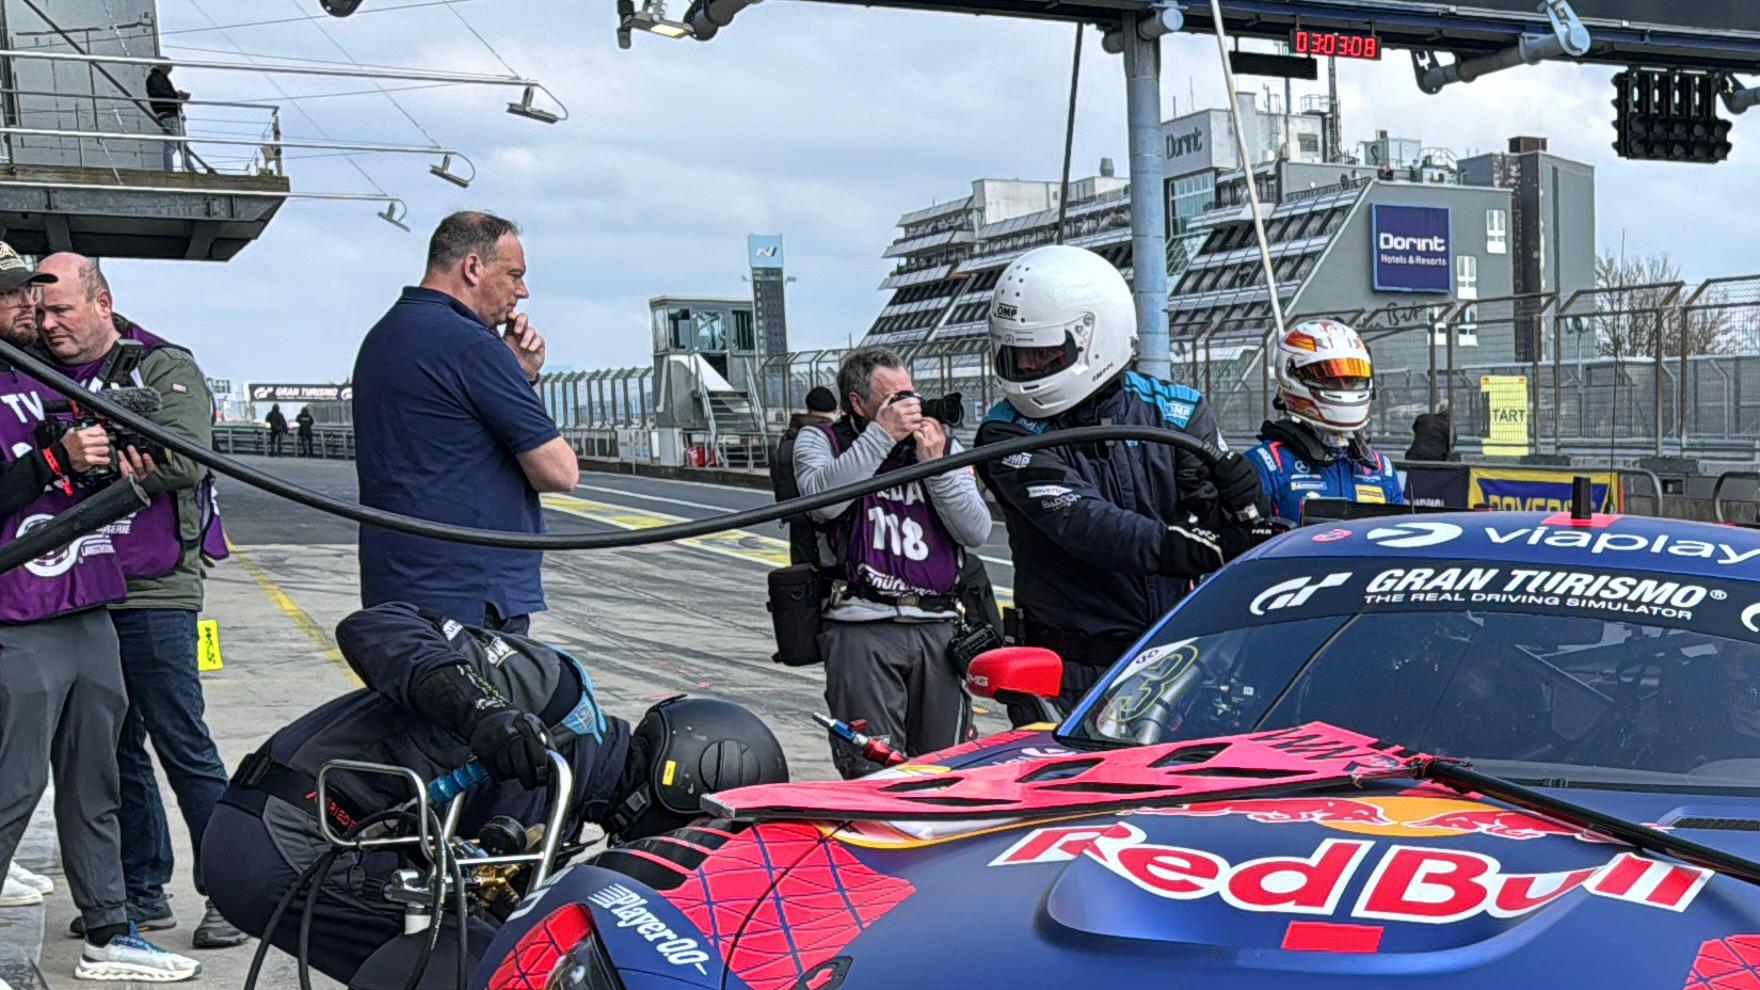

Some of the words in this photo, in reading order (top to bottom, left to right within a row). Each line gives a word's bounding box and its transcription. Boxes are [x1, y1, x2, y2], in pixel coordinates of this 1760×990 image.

[1296, 31, 1377, 58] 03:03:08
[1166, 126, 1203, 159] Dorint
[1380, 232, 1446, 252] Dorint
[1381, 253, 1407, 265] Hotels
[1416, 255, 1447, 266] Resorts
[2, 391, 46, 423] TV
[1491, 408, 1526, 423] TART
[1366, 567, 1500, 593] GRAN
[1364, 593, 1405, 604] THE
[1411, 592, 1465, 602] REAL
[1471, 593, 1560, 606] DRIVING
[1566, 597, 1693, 621] SIMULATOR
[988, 821, 1374, 915] Red
[1350, 844, 1716, 924] Bull
